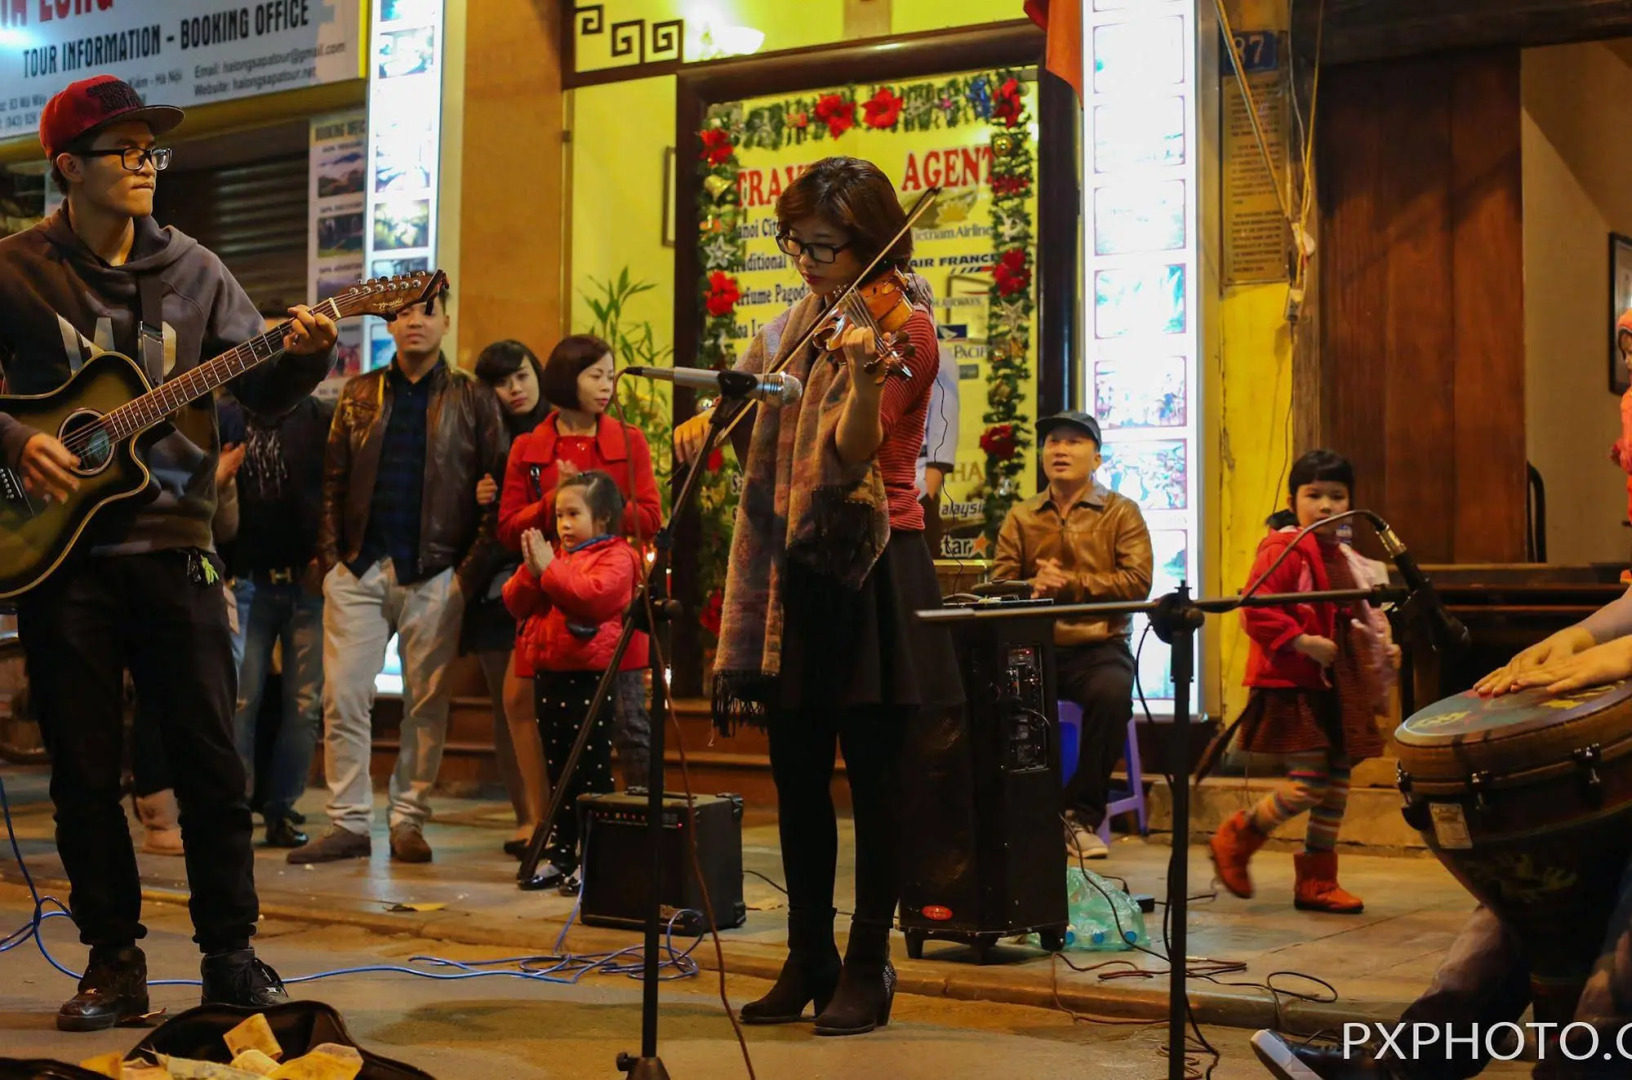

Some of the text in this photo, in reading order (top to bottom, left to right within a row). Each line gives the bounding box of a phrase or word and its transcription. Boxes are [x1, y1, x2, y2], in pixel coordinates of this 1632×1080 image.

[24, 45, 57, 78] TOUR
[62, 25, 160, 71] INFORMATION
[181, 7, 249, 50] BOOKING
[255, 0, 309, 36] OFFICE
[194, 62, 219, 79] Email:
[347, 119, 366, 135] OFFIC
[736, 163, 808, 209] TRAV
[735, 219, 759, 239] anoi
[913, 222, 995, 242] ietnam Airline
[731, 252, 787, 273] ditional
[908, 257, 934, 268] AIR
[738, 283, 809, 307] rfume Pagod
[954, 344, 987, 359] PACIF
[951, 462, 985, 482] HA
[941, 501, 985, 518] alaysi
[941, 534, 971, 556] tar
